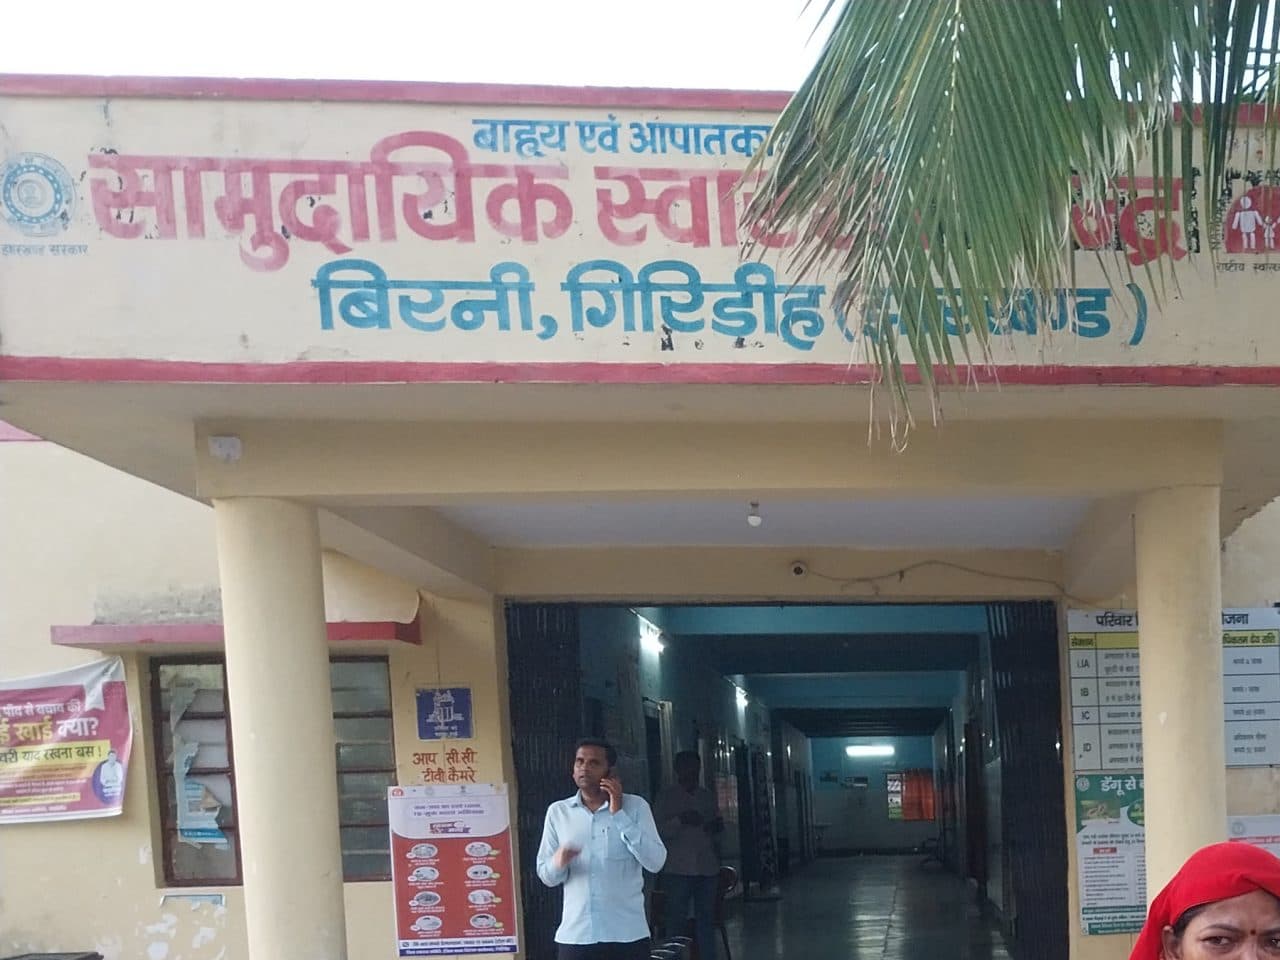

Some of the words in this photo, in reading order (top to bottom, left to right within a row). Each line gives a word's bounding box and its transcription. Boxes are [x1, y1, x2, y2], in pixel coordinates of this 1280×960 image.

[577, 113, 620, 153] एवं
[629, 122, 776, 157] आपातका
[89, 131, 573, 272] सामुदायिक
[311, 258, 558, 341] बिरनी,
[560, 258, 827, 351] गिरिडीह
[1096, 611, 1133, 627] परिवार
[56, 716, 99, 737] क्या?
[43, 746, 73, 761] रखना
[412, 751, 439, 767] आप
[421, 768, 446, 784] टीवी
[447, 766, 478, 784] कैमरे
[1125, 776, 1137, 790] से
